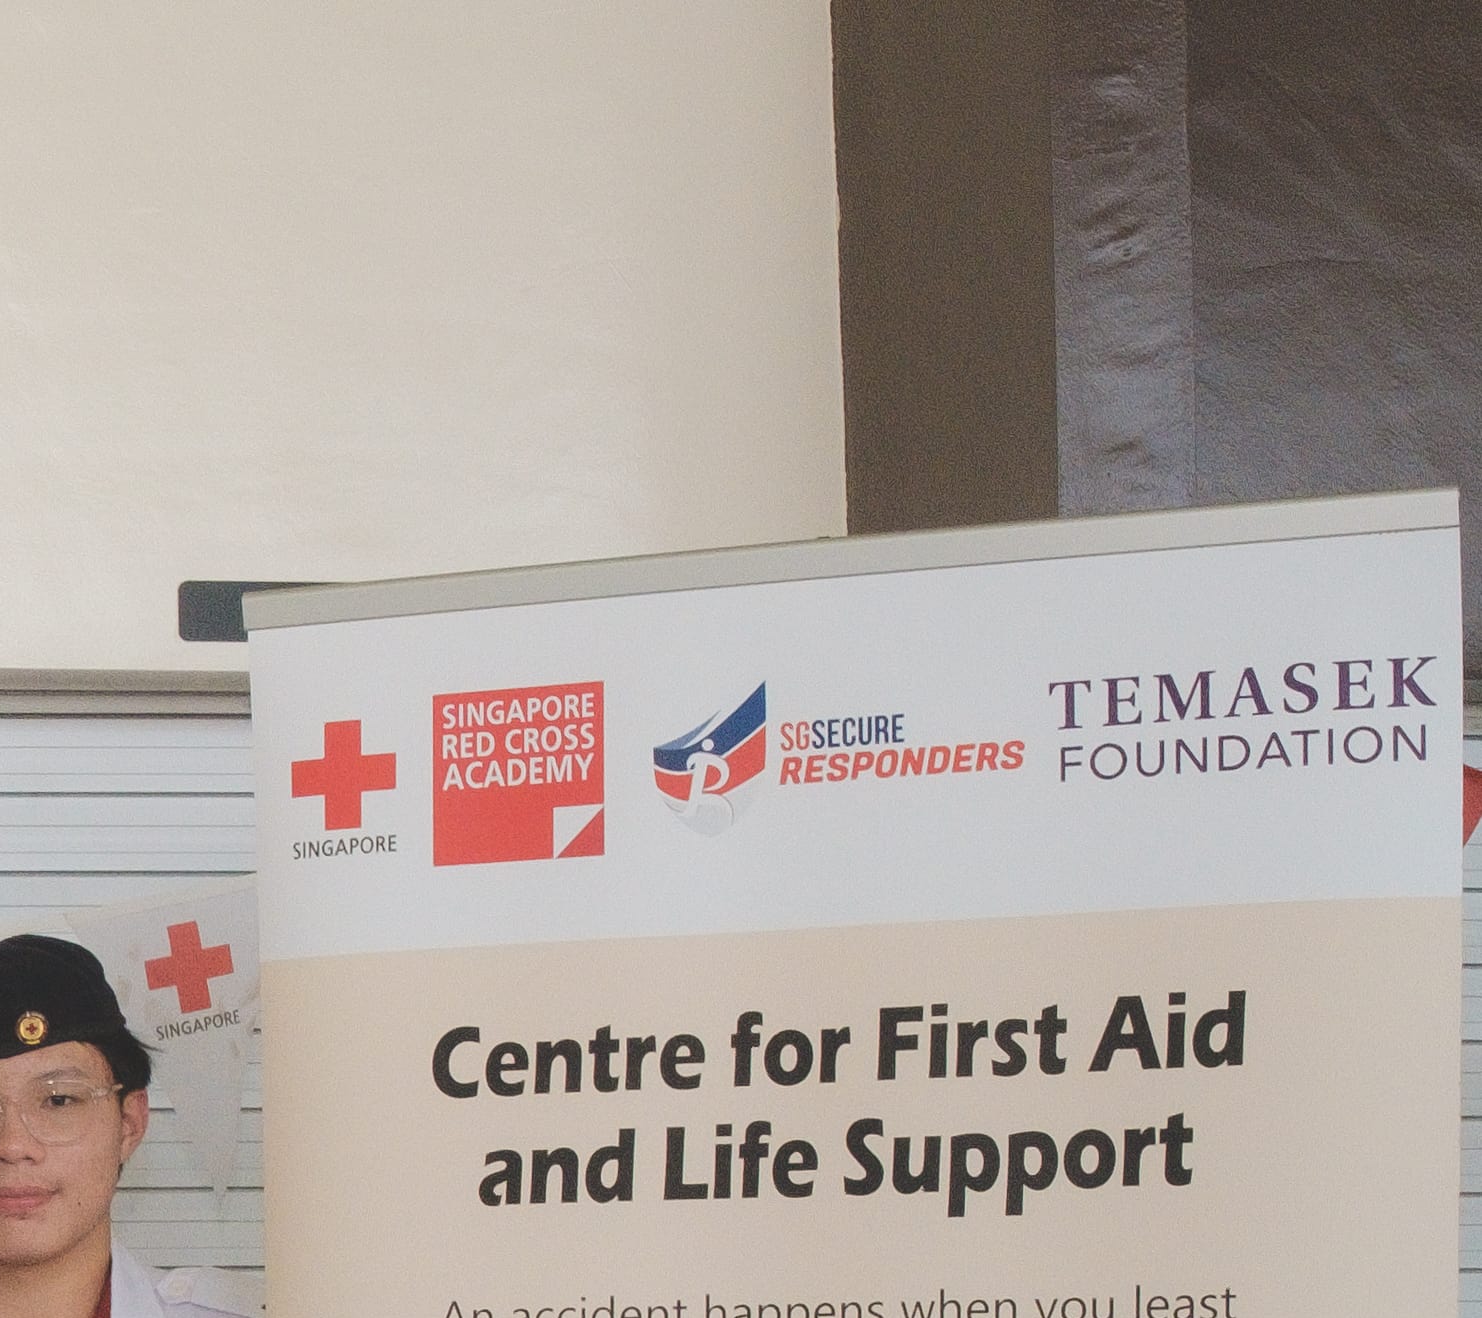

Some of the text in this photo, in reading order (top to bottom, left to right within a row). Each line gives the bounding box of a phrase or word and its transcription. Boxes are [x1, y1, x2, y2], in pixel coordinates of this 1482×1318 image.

[442, 692, 596, 730] SINGAPORE
[1049, 655, 1438, 730] TEMASEK
[442, 722, 596, 760] RED CROSS
[779, 712, 905, 750] SGSECURE
[779, 740, 1027, 786] RESPONDERS
[1059, 722, 1431, 783] FOUNDATION
[442, 755, 594, 792] ACADEMY
[292, 834, 398, 860] SINGAPORE
[155, 1009, 241, 1041] SINGAPORE
[431, 989, 1246, 1099] Centre for First Aid
[478, 1112, 1195, 1218] and Life Support
